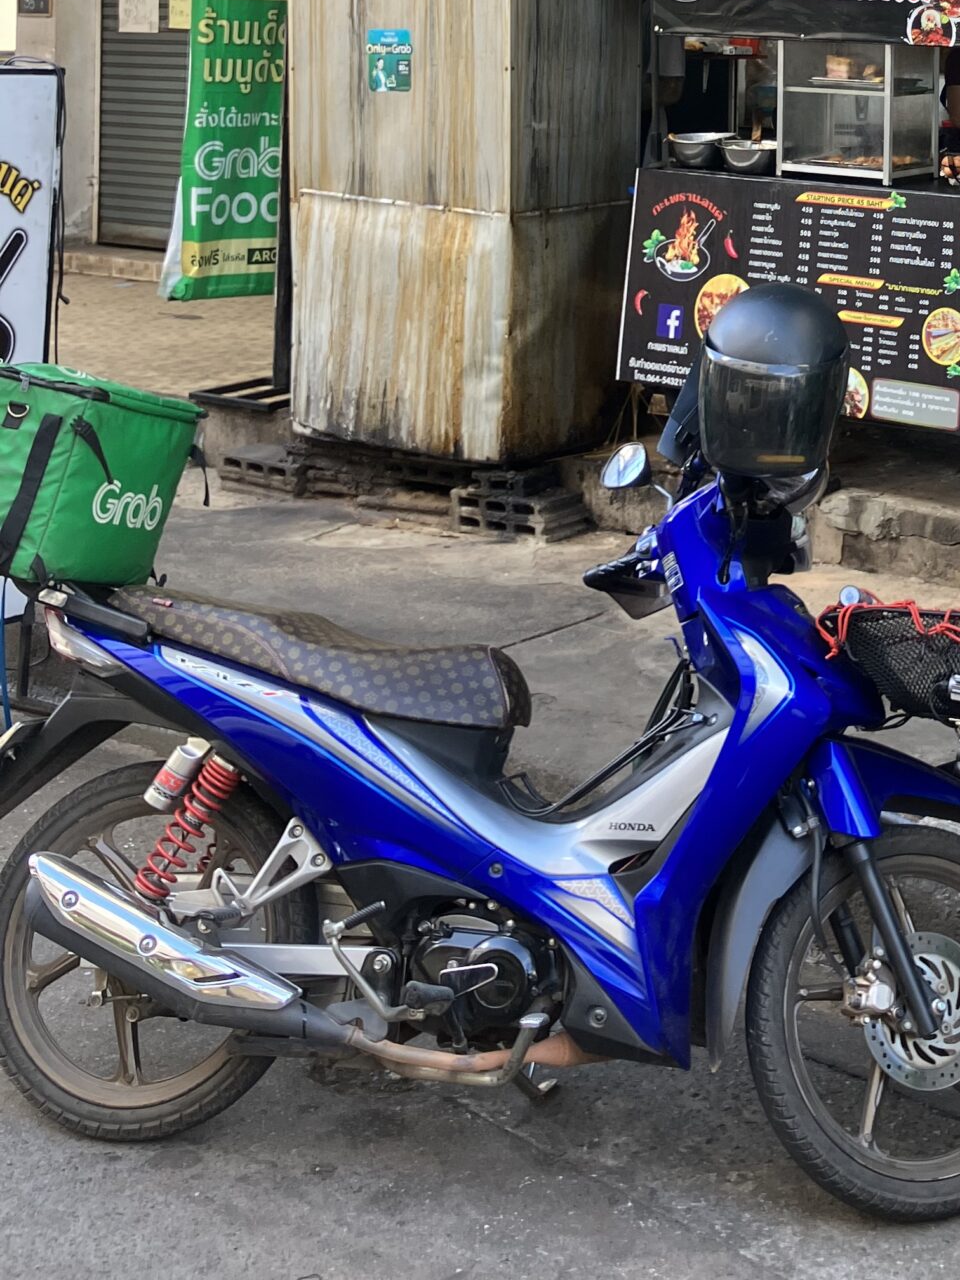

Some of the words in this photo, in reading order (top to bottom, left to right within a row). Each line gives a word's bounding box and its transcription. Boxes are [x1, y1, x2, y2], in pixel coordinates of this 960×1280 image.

[194, 102, 280, 128] สั่งได้เฉพาะ
[194, 136, 282, 181] Grab
[92, 479, 163, 531] Grab
[608, 822, 657, 832] HONDA
